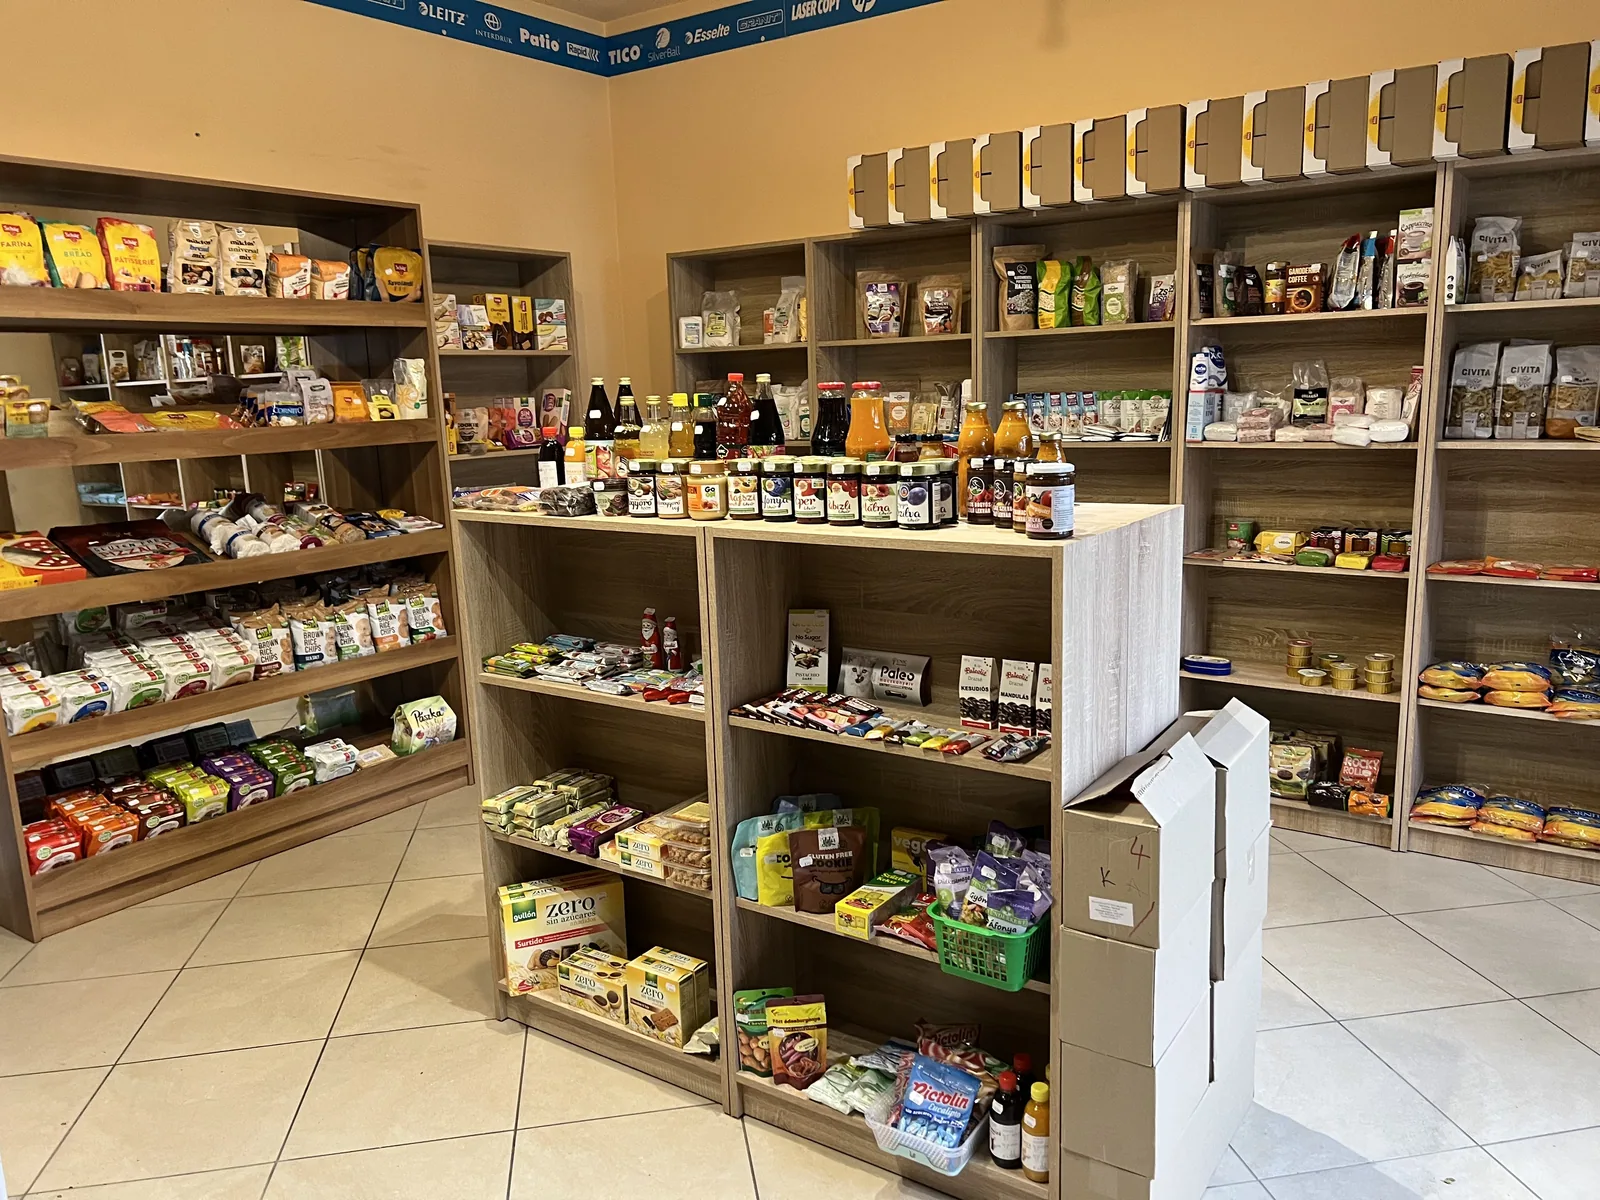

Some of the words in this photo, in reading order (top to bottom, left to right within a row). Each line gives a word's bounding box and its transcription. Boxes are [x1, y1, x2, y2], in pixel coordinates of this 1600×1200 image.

[429, 4, 466, 26] LEITZ
[791, 2, 817, 20] LASER
[817, 0, 841, 15] COPY
[475, 28, 513, 45] INTERDRUK
[693, 23, 730, 44] Esselte
[519, 27, 560, 52] Patio
[568, 44, 588, 57] Rapid
[608, 45, 641, 65] TICO
[647, 46, 681, 63] SilverBall
[1479, 235, 1508, 244] CIVITA
[191, 252, 206, 260] mix
[1288, 275, 1308, 284] COFFEE
[1461, 368, 1491, 376] CIVITA
[1510, 366, 1541, 374] CIVITA
[411, 606, 430, 615] BROWN
[377, 613, 397, 622] BROWN
[413, 614, 426, 622] RICE
[336, 624, 354, 632] BROWN
[379, 621, 390, 629] RICE
[415, 619, 430, 628] CHIPS
[303, 630, 324, 640] BROWN
[339, 630, 349, 638] RICE
[380, 626, 396, 636] CHIPS
[303, 638, 317, 646] RICE
[340, 636, 356, 646] CHIPS
[804, 634, 821, 642] Sugar
[258, 638, 279, 649] BROWN
[259, 647, 273, 656] RICE
[304, 645, 322, 653] CHIPS
[260, 654, 279, 664] CHIPS
[880, 665, 915, 682] Paleo
[1000, 691, 1029, 701] MANDULÁS
[411, 708, 444, 728] Pászka
[1343, 756, 1380, 770] ROCKY
[1343, 766, 1362, 776] ROLL
[835, 850, 853, 859] FREE
[1130, 836, 1151, 870] 4
[545, 896, 595, 918] zero
[513, 910, 536, 922] gullón
[546, 918, 559, 926] sin
[560, 910, 597, 923] azúcares
[988, 918, 1017, 934] Áfonya
[517, 938, 543, 948] Surtido
[574, 973, 596, 988] zero
[640, 984, 664, 1000] zero
[912, 1081, 969, 1109] Pictolin
